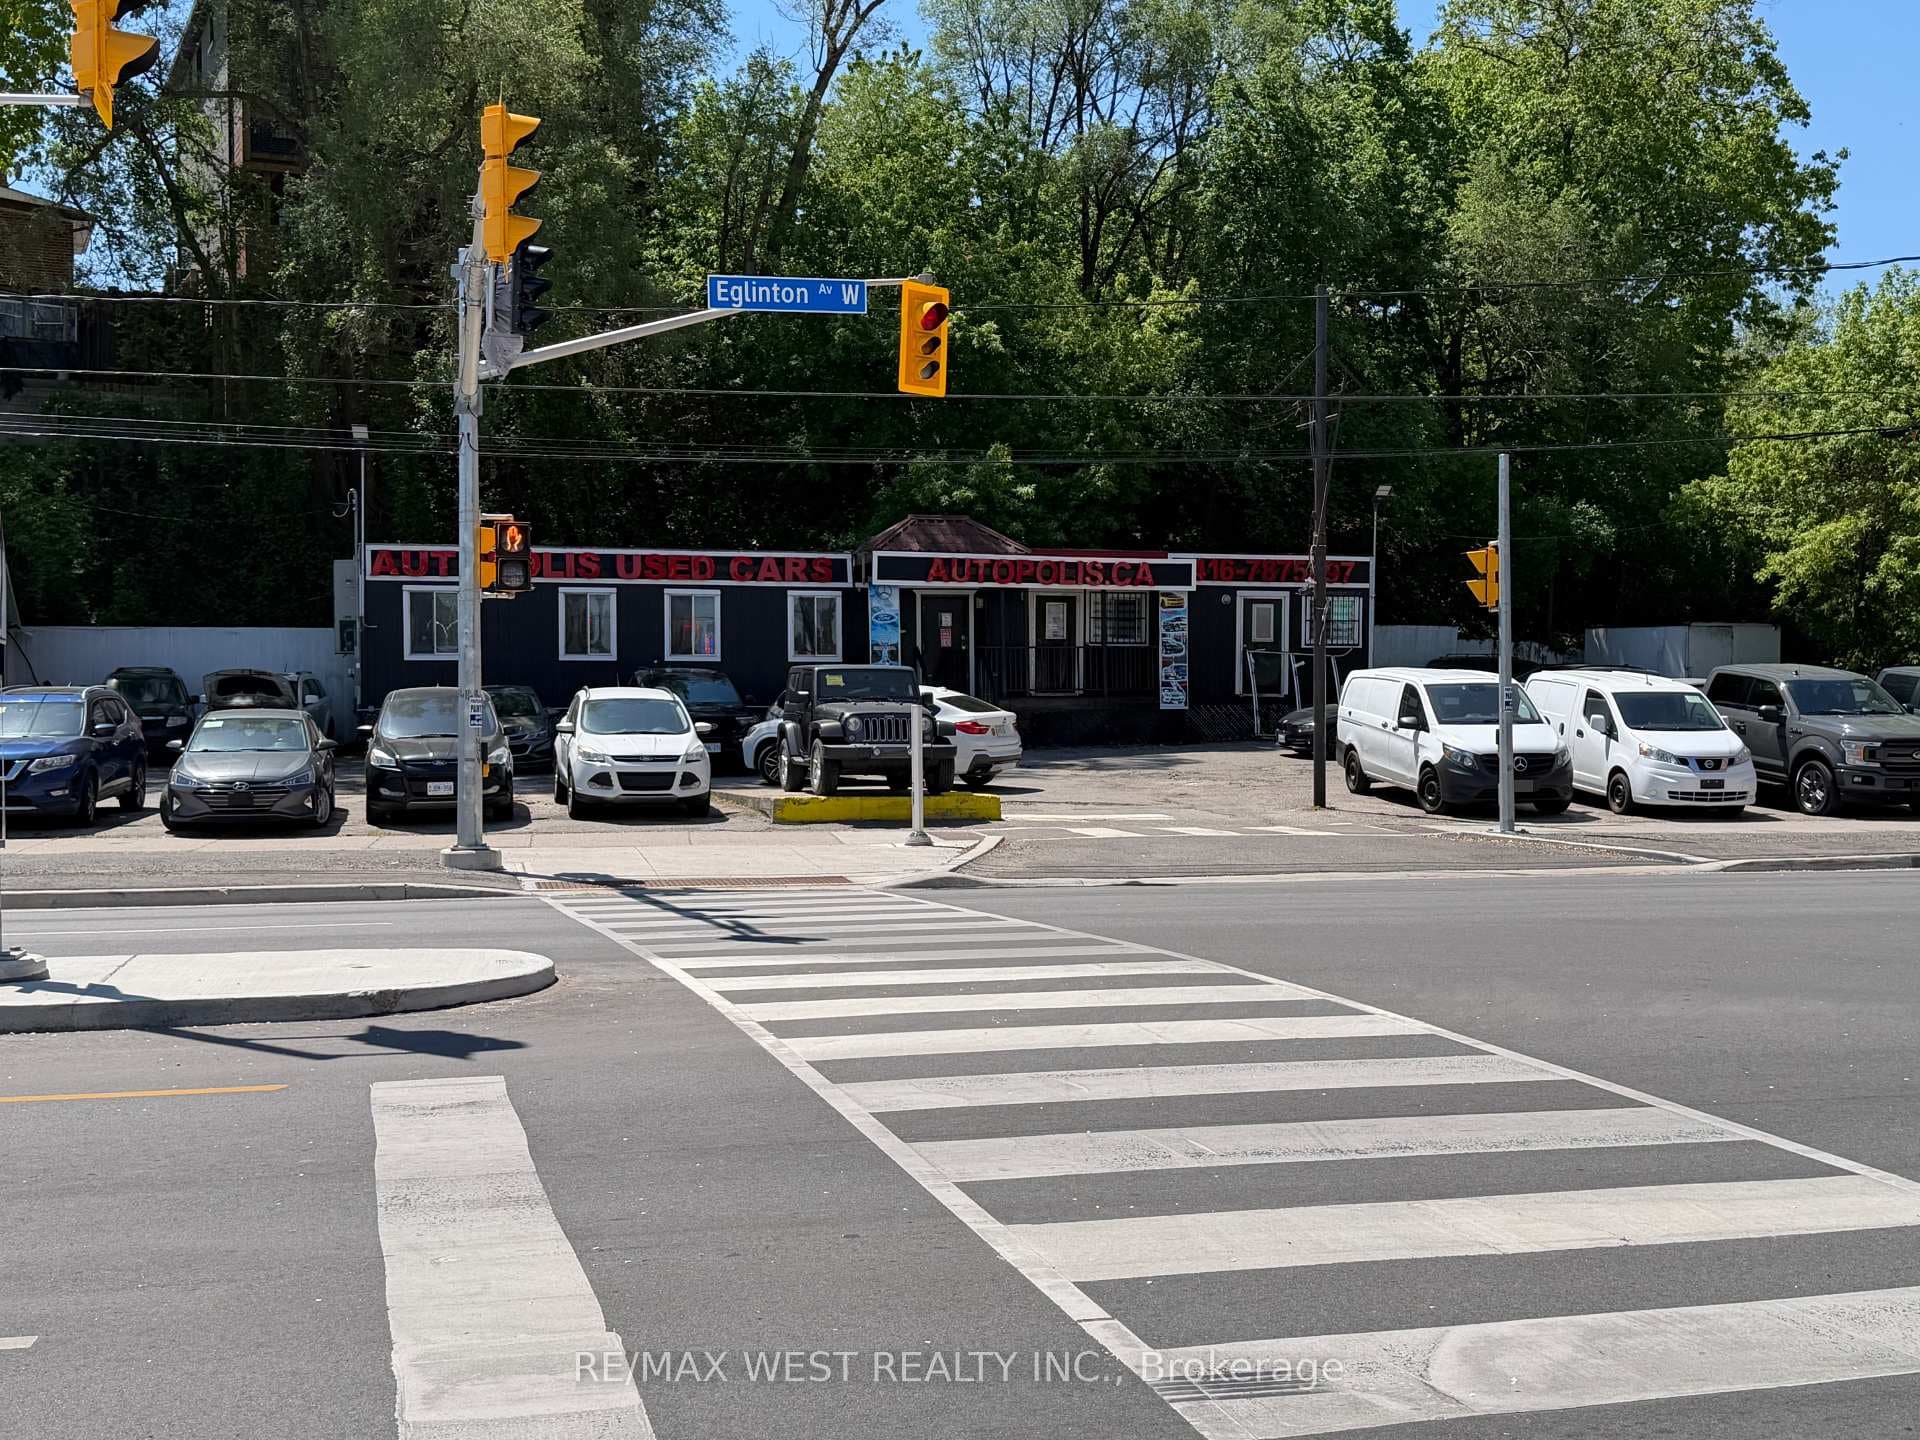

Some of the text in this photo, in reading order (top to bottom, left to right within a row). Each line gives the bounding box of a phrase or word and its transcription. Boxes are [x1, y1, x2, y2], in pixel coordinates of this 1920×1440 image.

[717, 281, 860, 307] Eglinton Av W
[371, 550, 833, 582] AUTLIS USED CARS
[928, 558, 1155, 586] AUTOPOLIS.CA
